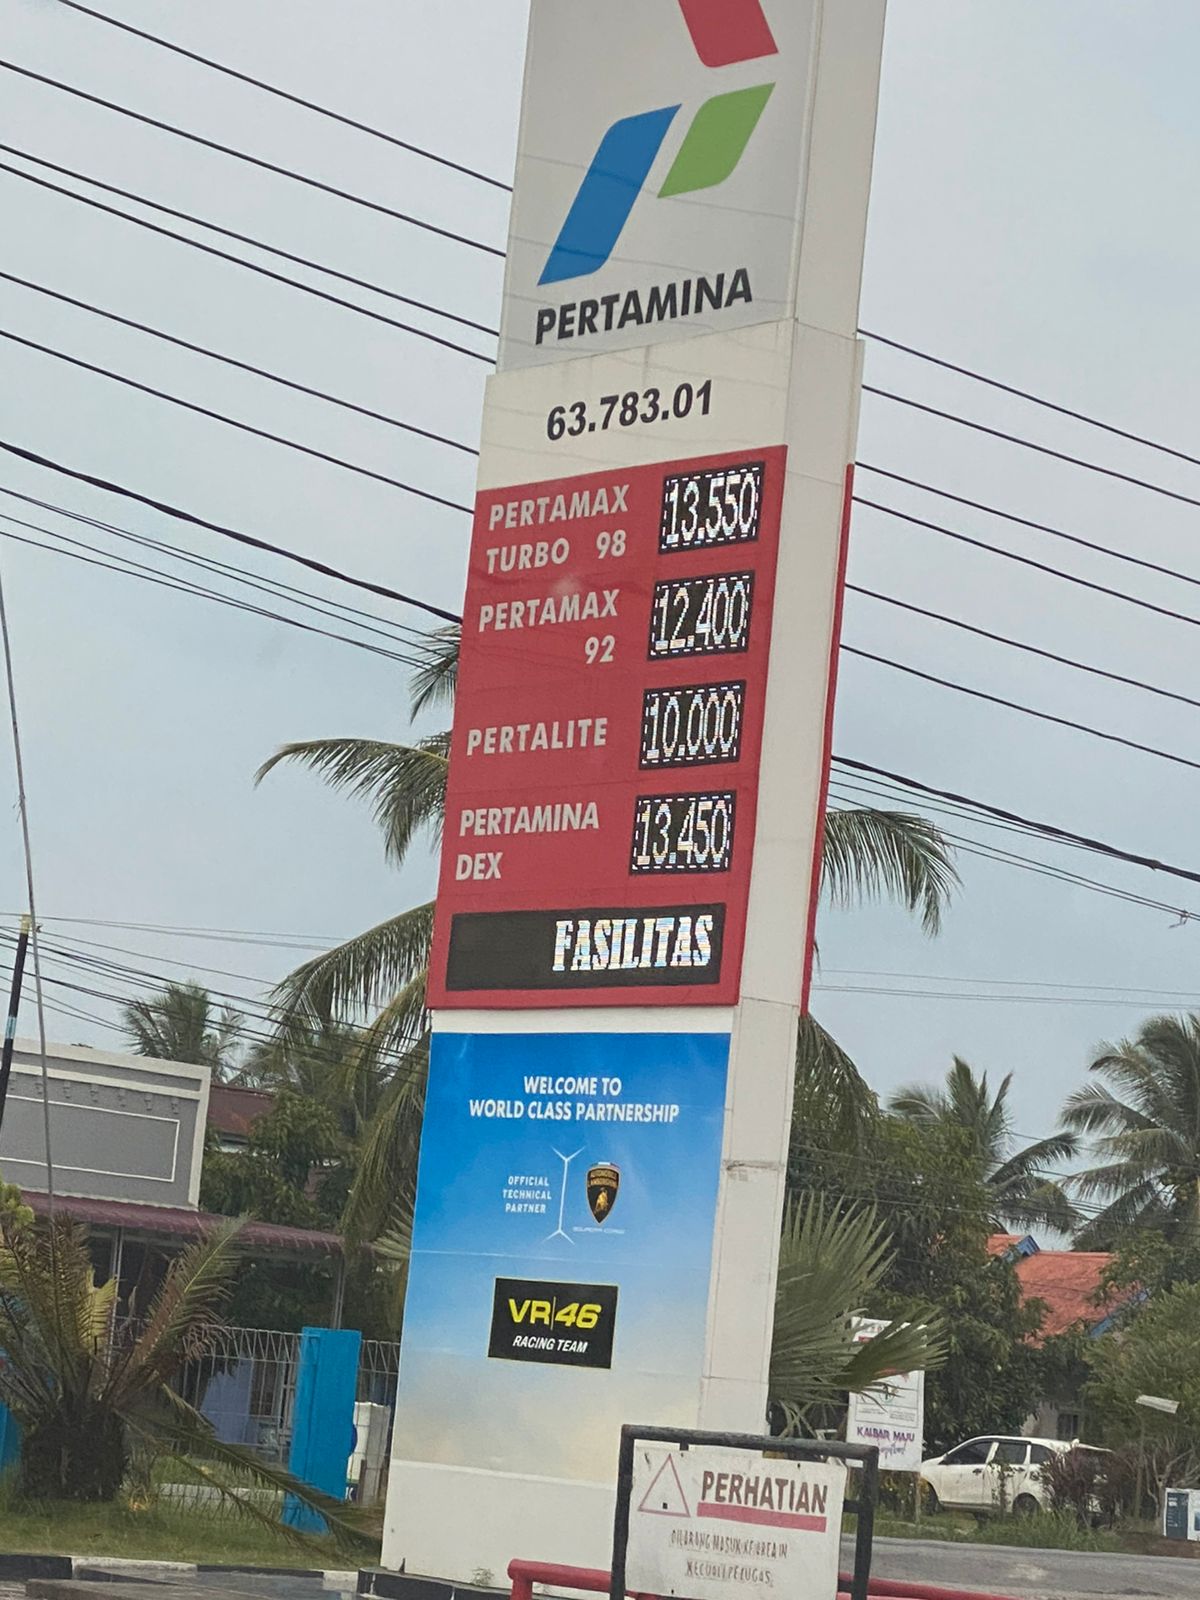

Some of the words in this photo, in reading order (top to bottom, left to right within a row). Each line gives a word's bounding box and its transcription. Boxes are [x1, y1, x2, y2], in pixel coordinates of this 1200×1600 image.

[535, 268, 752, 345] PERTAMINA
[547, 379, 712, 440] 63.783.01
[489, 484, 630, 531] PERTAMAX
[666, 471, 757, 543] 13.550
[486, 538, 569, 574] TURBO
[596, 530, 627, 559] 98
[478, 589, 620, 632] PERTAMAX
[655, 581, 747, 649] 12.400
[584, 635, 615, 664] 92
[466, 718, 608, 756] PERTALITE
[646, 690, 737, 759] 10.000
[459, 802, 599, 837] PERTAMINA
[637, 799, 728, 865] 13.450
[455, 852, 503, 881] DEX
[552, 915, 713, 972] FASILITAS
[524, 1075, 597, 1095] WELCOME
[601, 1077, 622, 1096] TO
[469, 1099, 524, 1119] WORLD
[528, 1101, 571, 1120] CLASS
[576, 1103, 680, 1123] PARTNERSHIP
[502, 1188, 552, 1200] TECHNICAL
[508, 1175, 549, 1187] OFFICIAL
[505, 1202, 546, 1214] PARTNER
[512, 1335, 555, 1350] RACING
[557, 1338, 588, 1353] TEAM
[701, 1470, 828, 1514] PERHATIAN
